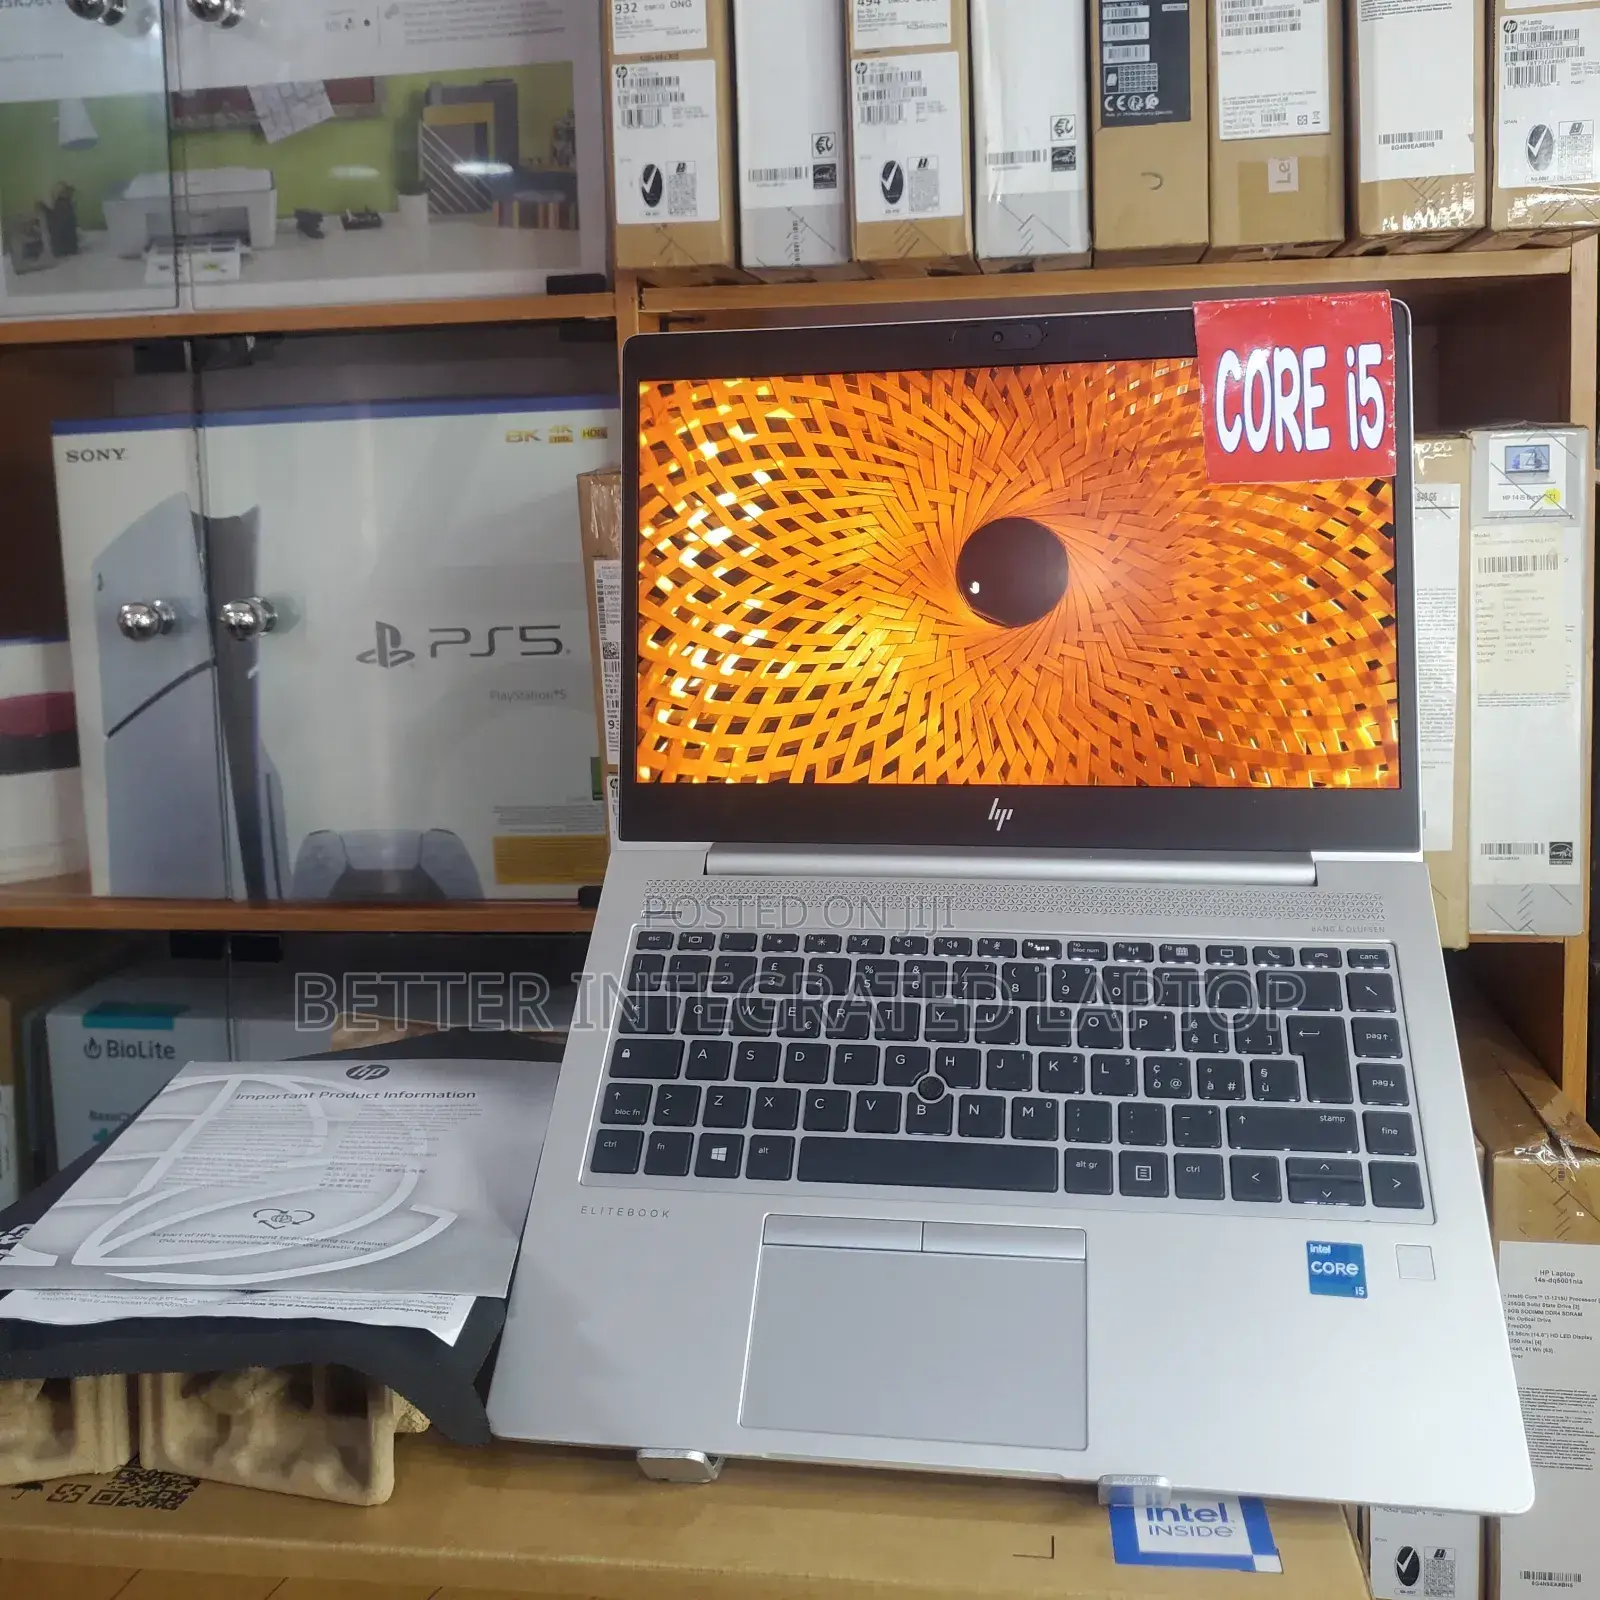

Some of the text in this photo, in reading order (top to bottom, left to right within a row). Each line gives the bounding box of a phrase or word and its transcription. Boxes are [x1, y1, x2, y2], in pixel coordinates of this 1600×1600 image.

[614, 2, 638, 14] 932
[1215, 342, 1386, 453] CORE i5
[66, 448, 125, 463] SONY
[429, 625, 563, 658] PS5
[988, 798, 1014, 831] hp
[1012, 983, 1019, 992] 8
[1062, 985, 1070, 994] 9
[693, 1005, 703, 1014] Q
[742, 1006, 755, 1015] W
[788, 1007, 796, 1016] E
[836, 1009, 845, 1018] R
[885, 1010, 893, 1019] T
[936, 1011, 945, 1020] Y
[986, 1013, 995, 1022] U
[1088, 1016, 1099, 1027] O
[1139, 1019, 1148, 1029] P
[107, 1040, 176, 1059] BioLite
[698, 1049, 708, 1059] A
[746, 1050, 754, 1060] S
[795, 1052, 805, 1062] D
[844, 1053, 853, 1063] F
[896, 1055, 905, 1064] G
[946, 1056, 954, 1066] H
[997, 1059, 1004, 1069] J
[1050, 1061, 1059, 1071] K
[346, 1064, 390, 1080] hp
[1102, 1063, 1109, 1073] L
[1170, 1078, 1182, 1089] @
[1228, 1082, 1236, 1091] #
[236, 1090, 476, 1101] Important Product Information
[714, 1096, 723, 1106] Z
[764, 1097, 774, 1107] X
[815, 1099, 824, 1109] C
[867, 1100, 876, 1110] V
[615, 1108, 631, 1116] bloc
[917, 1105, 926, 1115] B
[969, 1105, 979, 1115] N
[1023, 1107, 1034, 1117] M
[1320, 1114, 1345, 1124] stamp
[1382, 1127, 1398, 1135] fine
[604, 1140, 617, 1148] ctrl
[1089, 1161, 1098, 1170] gr
[580, 1206, 669, 1218] ELITEBOOK
[1310, 1244, 1331, 1254] intel
[1355, 1286, 1364, 1296] i5
[1146, 1502, 1228, 1523] intel
